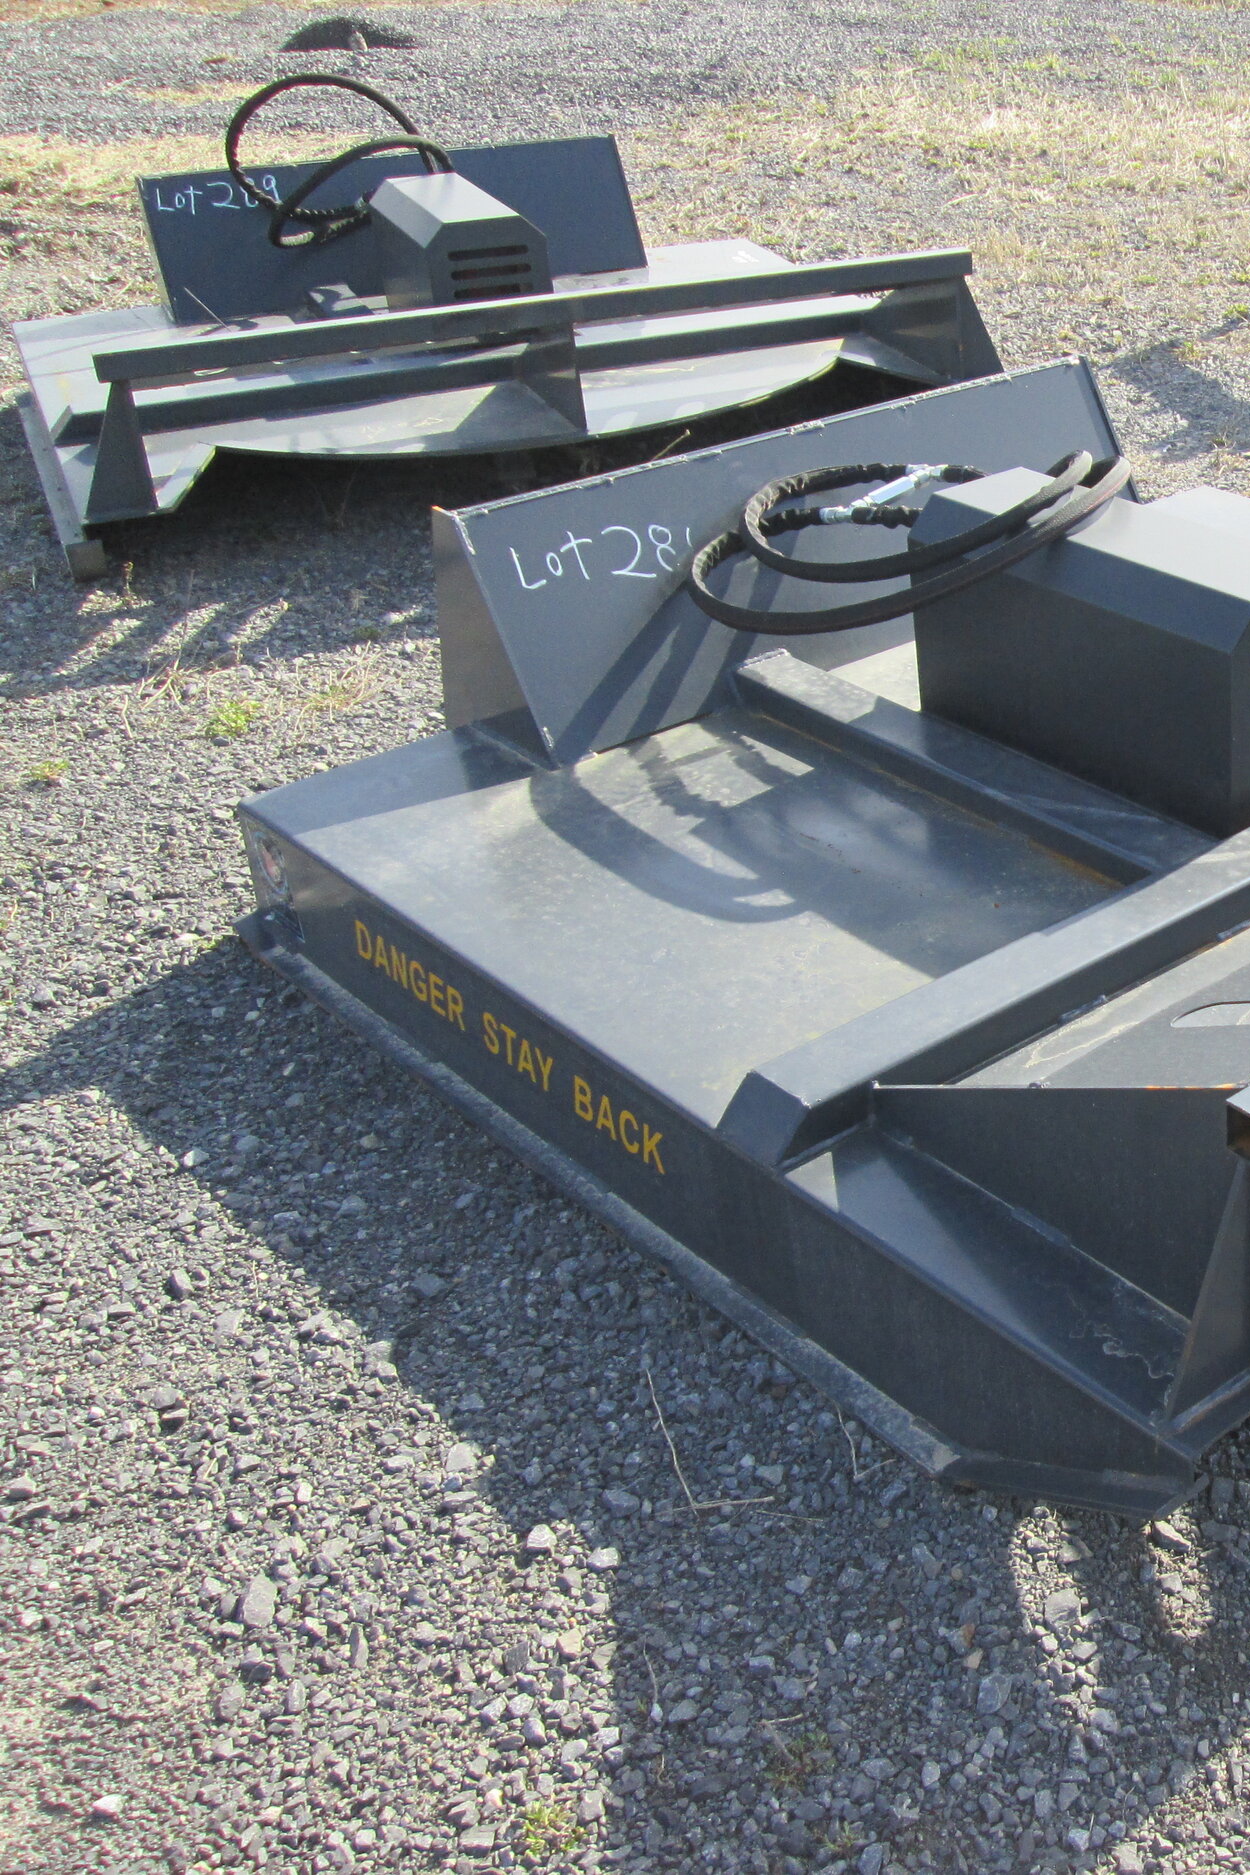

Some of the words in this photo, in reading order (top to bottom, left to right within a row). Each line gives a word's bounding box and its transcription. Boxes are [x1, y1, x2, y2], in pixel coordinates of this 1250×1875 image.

[156, 185, 203, 215] Lot
[509, 530, 593, 589] Lot
[354, 919, 466, 1031] DANGER
[482, 1012, 554, 1092] STAY
[573, 1074, 666, 1175] BACK
